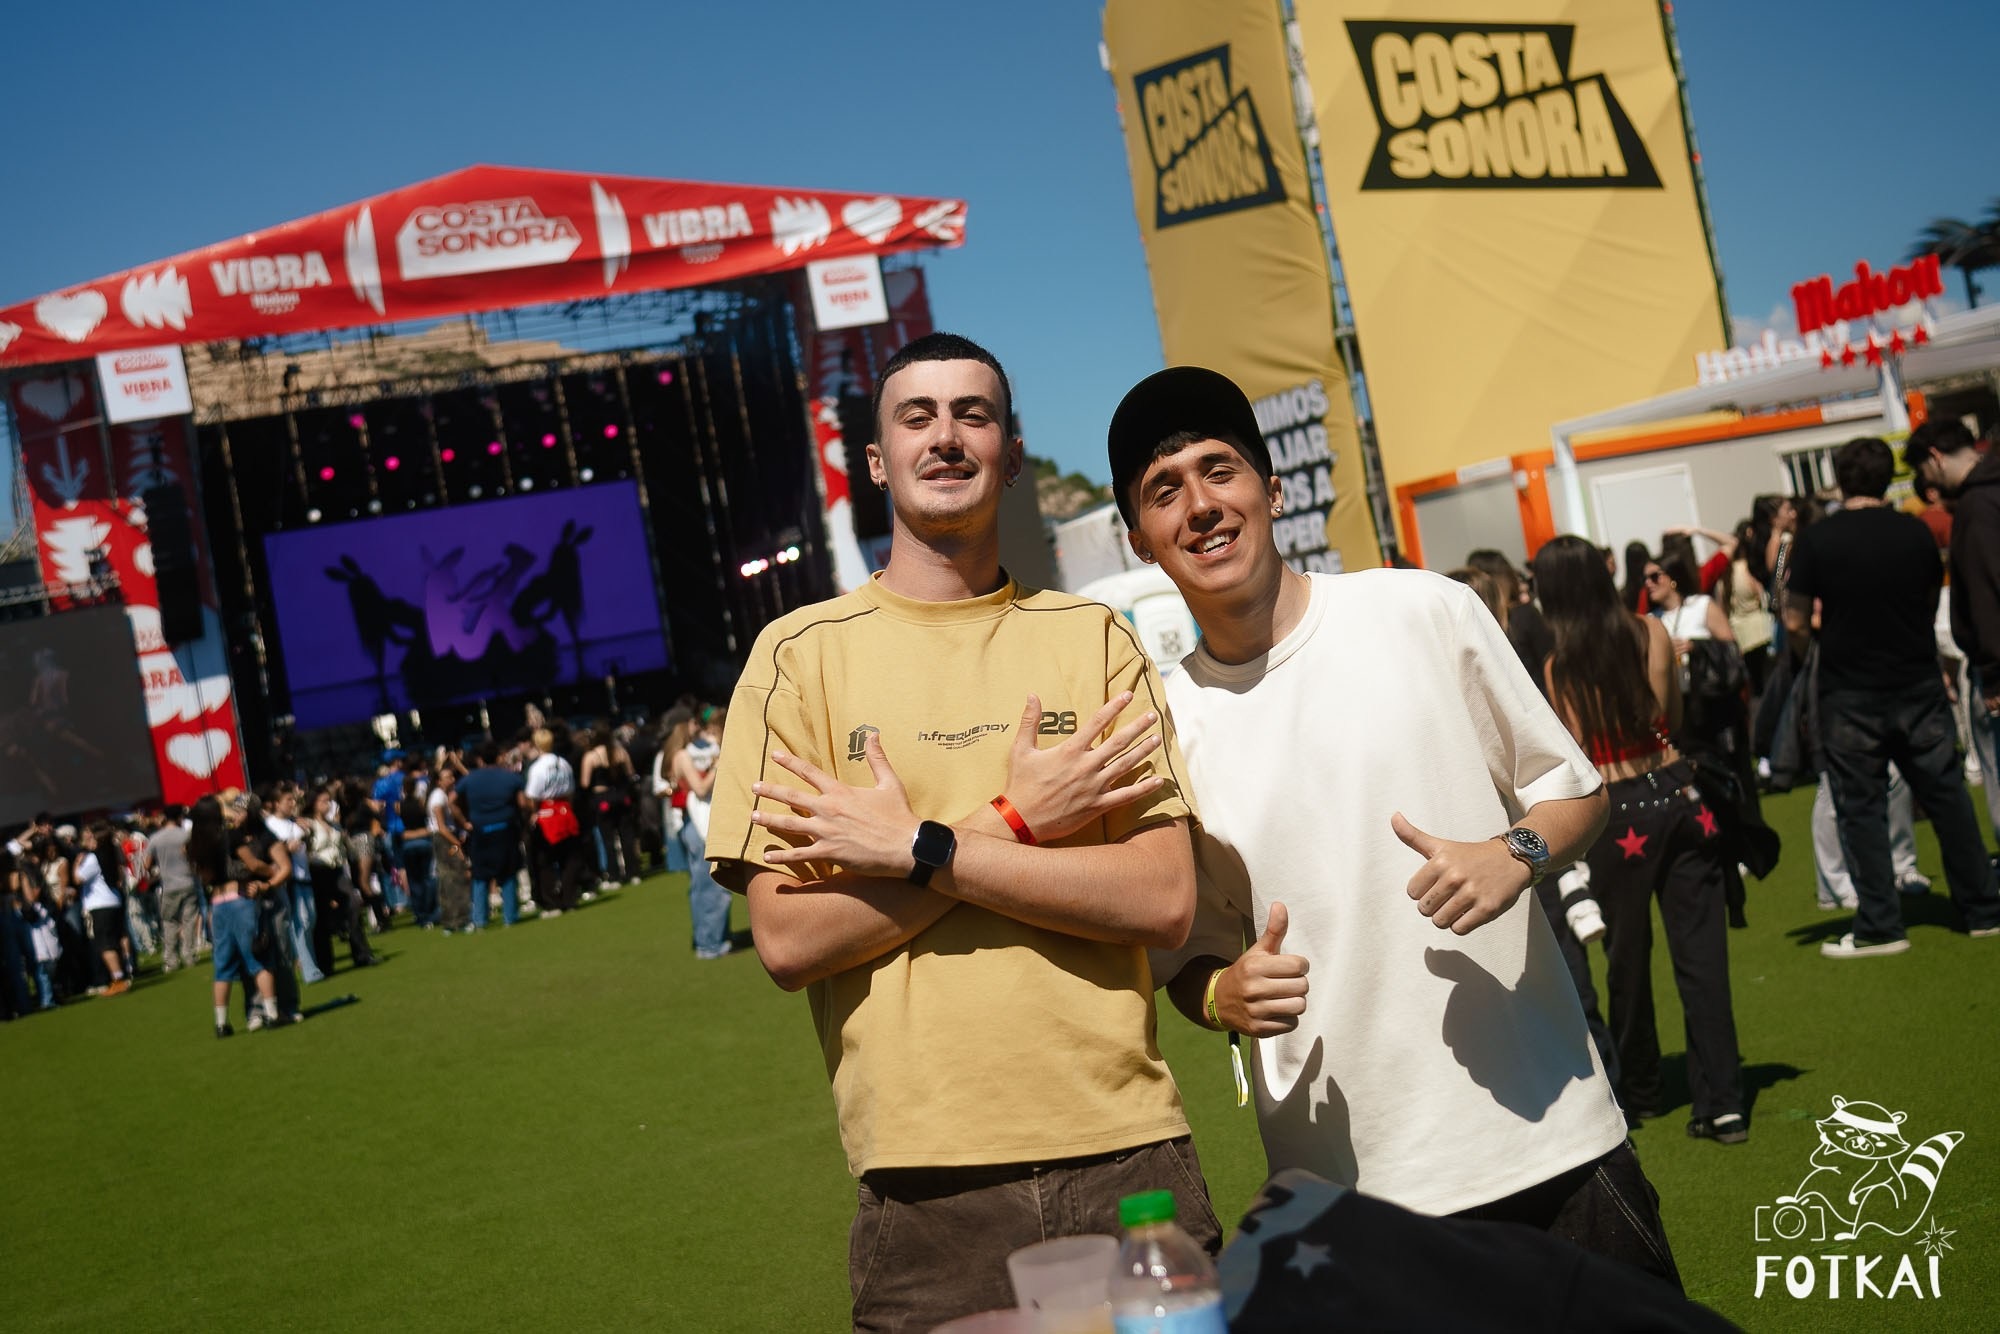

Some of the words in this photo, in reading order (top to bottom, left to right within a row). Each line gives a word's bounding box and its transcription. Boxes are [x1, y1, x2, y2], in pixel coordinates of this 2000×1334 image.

[1372, 32, 1564, 129] COSTA
[1144, 57, 1228, 169] COSTA
[1388, 78, 1628, 179] SONORA
[415, 201, 543, 232] COSTA
[417, 221, 576, 257] SONORA
[642, 202, 754, 249] VIBRA
[210, 251, 333, 297] VIBRA
[1314, 465, 1336, 505] A
[1038, 711, 1077, 735] 28
